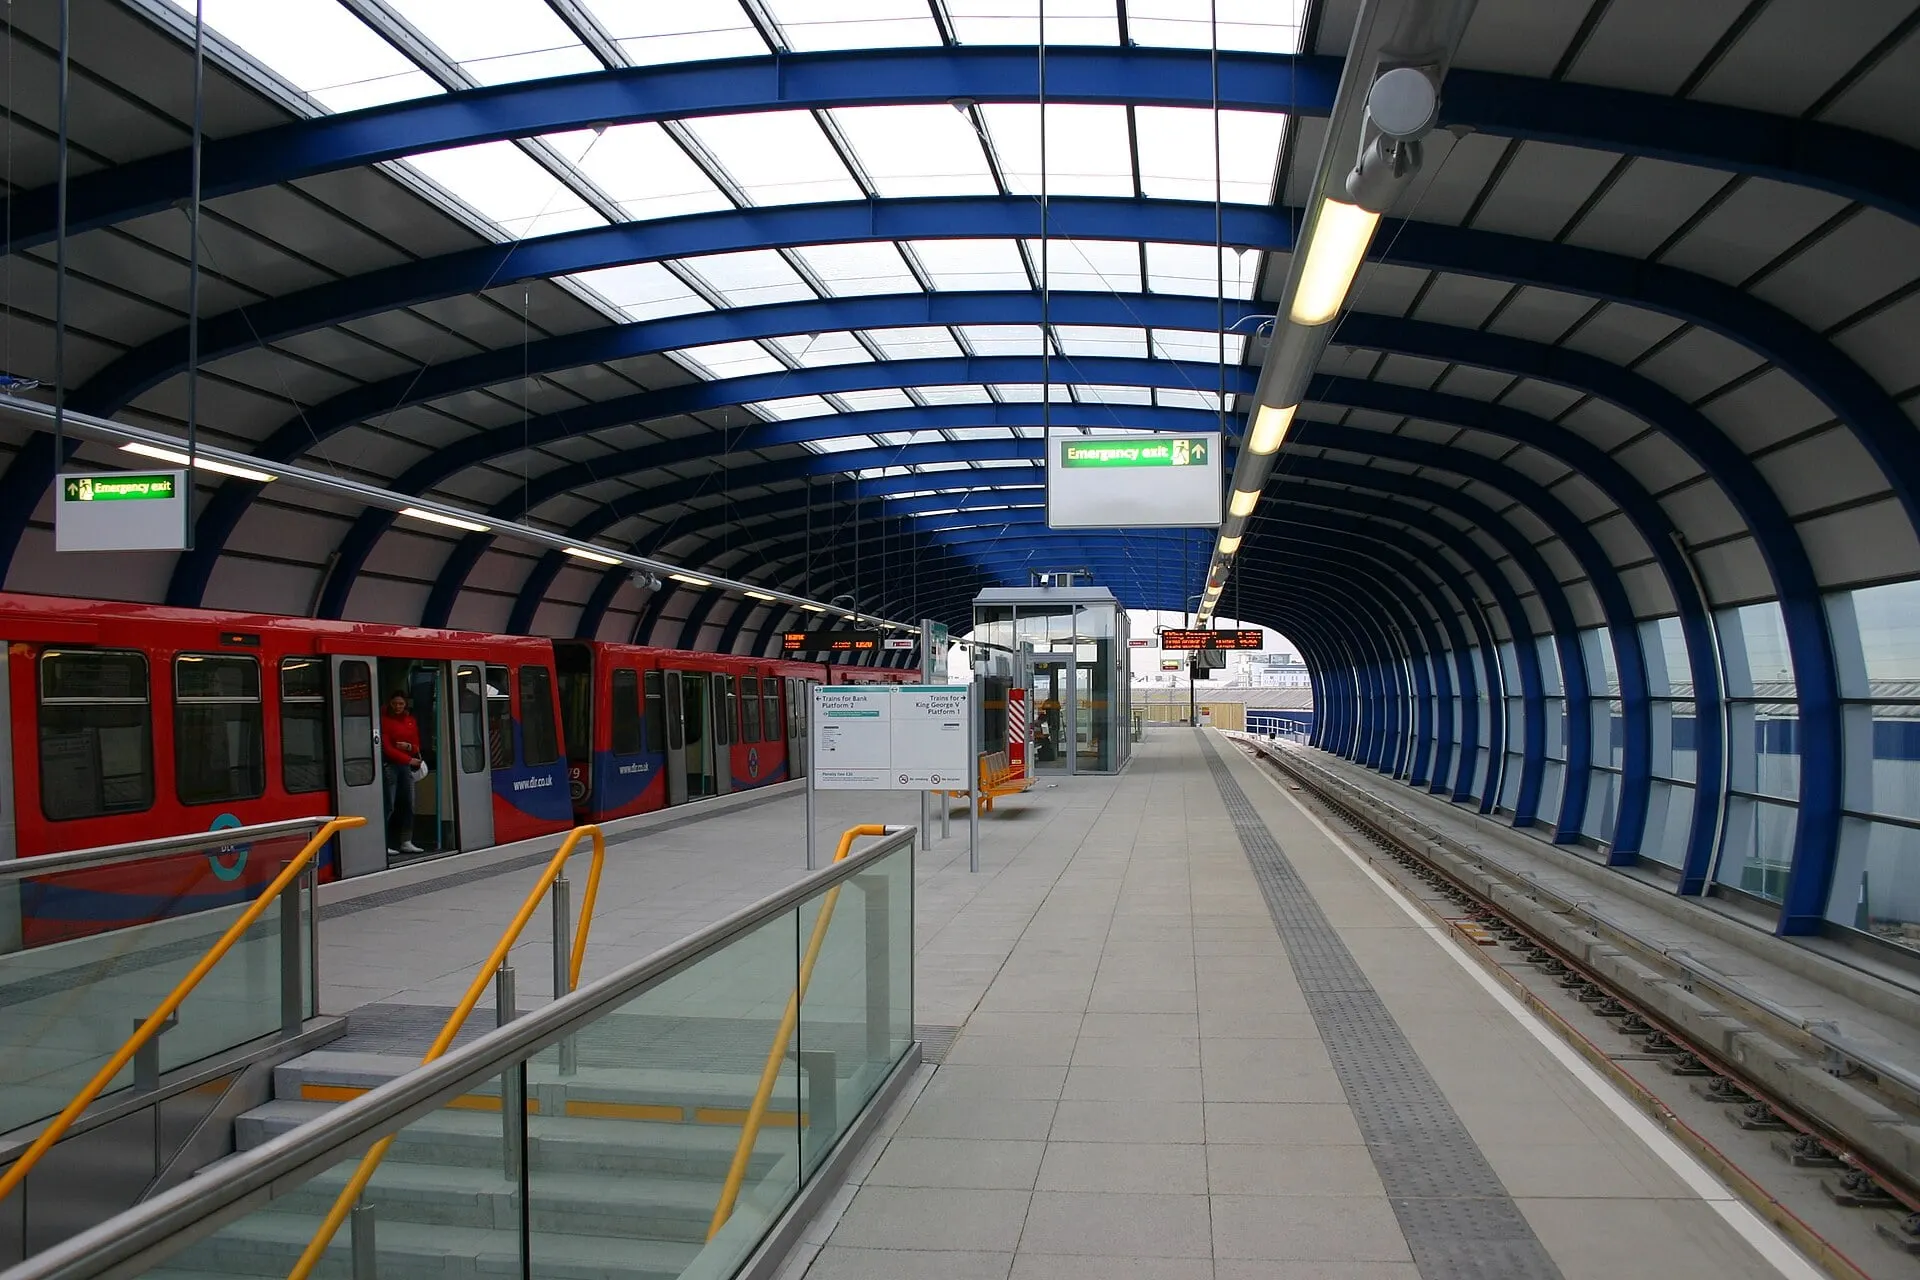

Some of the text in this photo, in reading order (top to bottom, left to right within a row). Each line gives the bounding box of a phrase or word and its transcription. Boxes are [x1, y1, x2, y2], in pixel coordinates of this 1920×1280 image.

[1067, 445, 1169, 462] Emergency exit
[95, 480, 172, 494] Emergency exit
[619, 761, 649, 774] www.dlr.co.uk
[513, 774, 553, 791] www.dlr.co.uk
